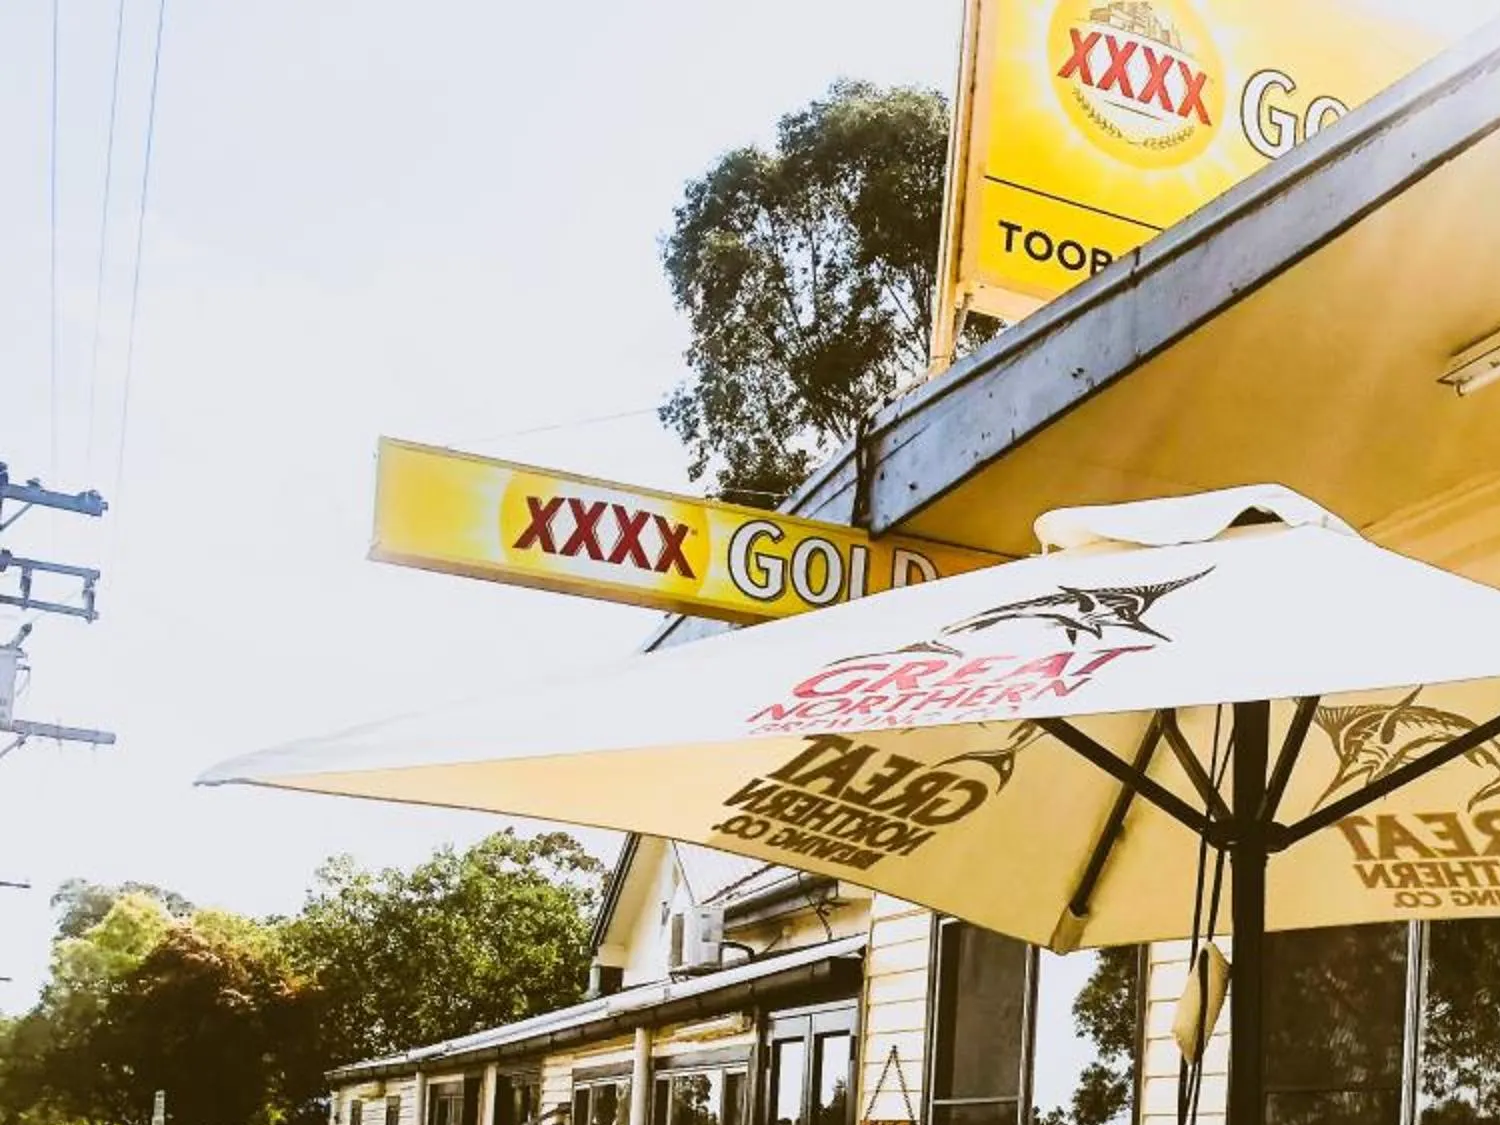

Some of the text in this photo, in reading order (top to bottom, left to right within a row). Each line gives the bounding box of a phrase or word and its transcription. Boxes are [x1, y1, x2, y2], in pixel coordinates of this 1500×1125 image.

[1056, 27, 1213, 127] XXXX
[513, 496, 697, 579] XXXX
[745, 677, 1092, 724] NORTHERN
[793, 644, 1156, 698] GREAT
